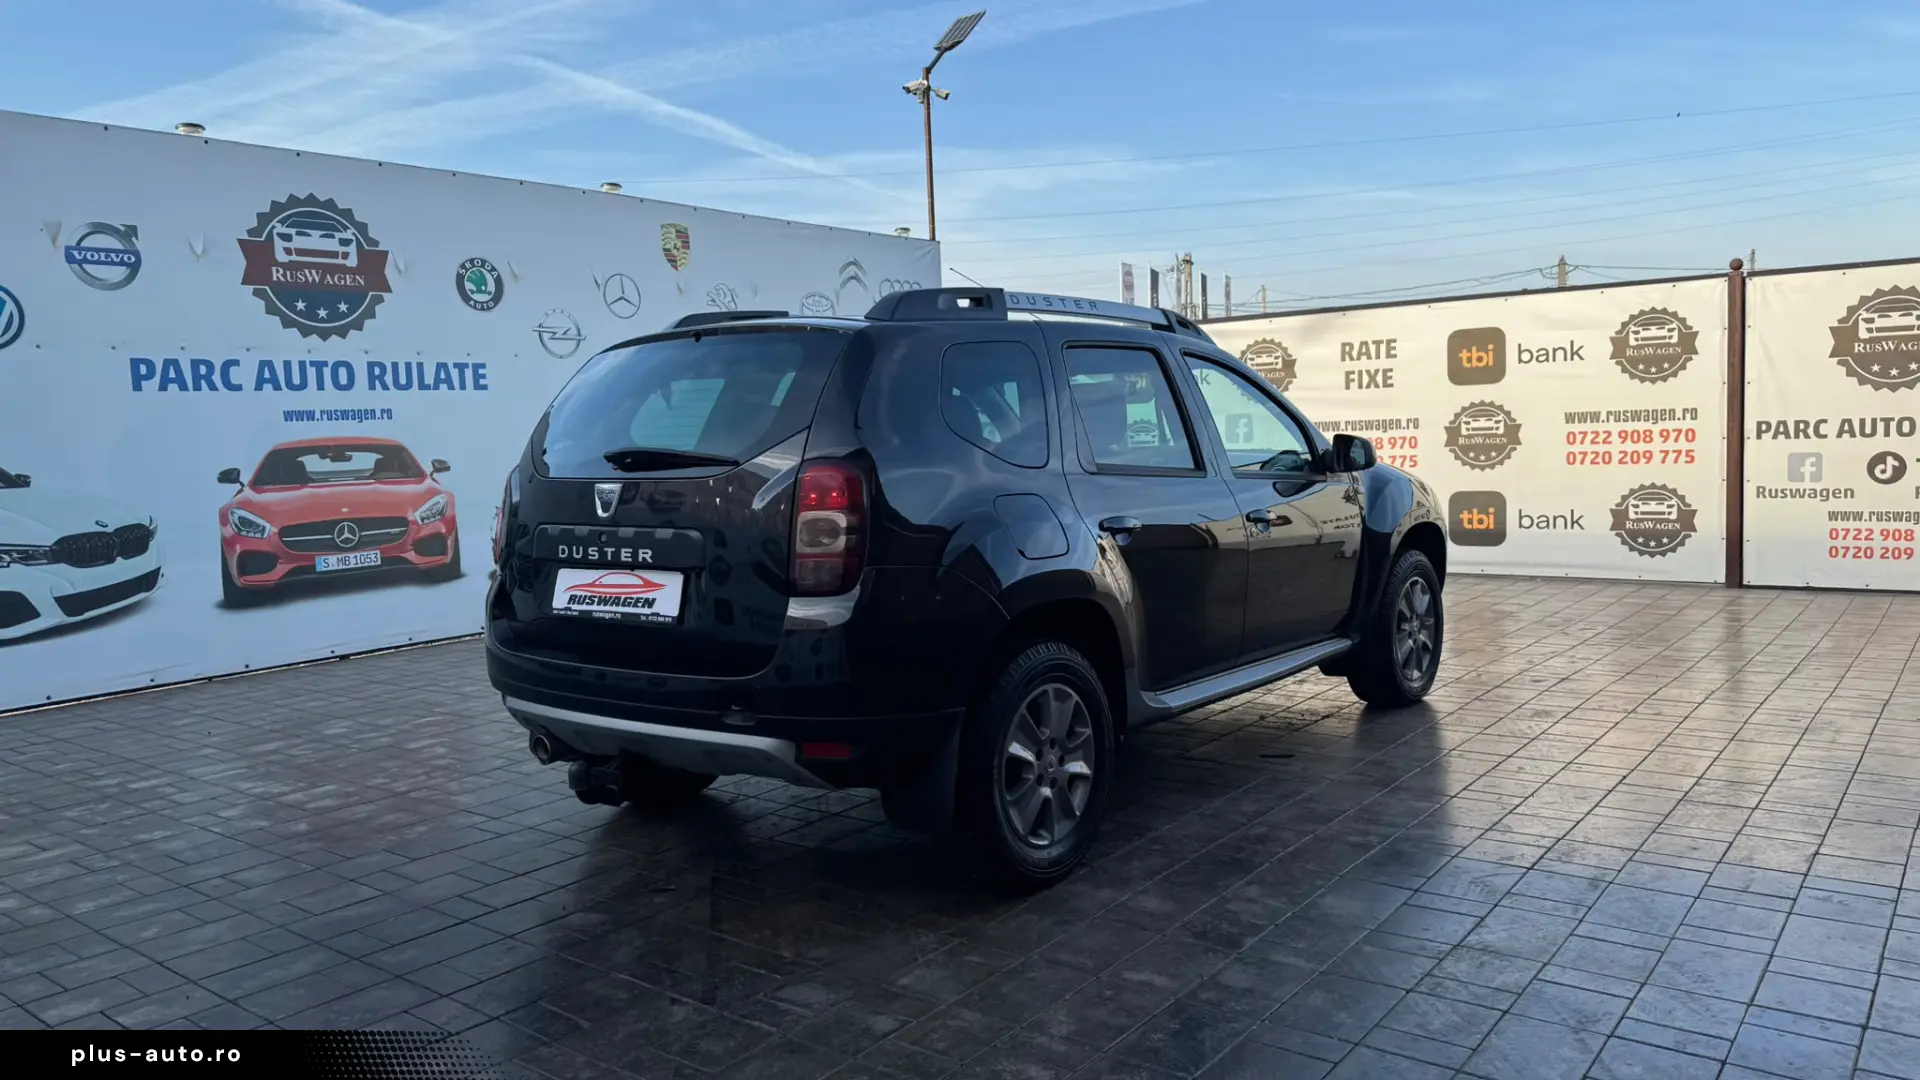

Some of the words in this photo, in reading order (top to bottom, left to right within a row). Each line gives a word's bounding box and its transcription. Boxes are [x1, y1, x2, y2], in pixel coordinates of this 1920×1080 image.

[69, 249, 137, 264] VOLVO
[468, 300, 495, 310] AUTO
[1010, 293, 1101, 312] DUSTER
[1340, 338, 1398, 362] RATE
[1458, 344, 1495, 369] tbi
[1517, 340, 1585, 365] bank
[129, 357, 243, 392] PARC
[254, 359, 356, 392] AUTO
[367, 360, 489, 391] RULATE
[1344, 367, 1394, 390] FIXE
[283, 408, 393, 424] www.ruswagen.ro
[1564, 407, 1698, 425] www.ruswagen.ro
[1566, 430, 1613, 446] 0722
[1617, 429, 1654, 445] 908
[1659, 428, 1696, 444] 970
[1755, 419, 1828, 440] PARC
[1836, 416, 1917, 438] AUTO
[1387, 436, 1418, 449] 970
[1388, 455, 1418, 468] 775
[1566, 450, 1613, 466] 0720
[1617, 450, 1654, 465] 209
[1659, 449, 1696, 465] 775
[1756, 485, 1855, 502] Ruswagen
[1460, 507, 1495, 530] tbi
[1518, 509, 1585, 530] bank
[1828, 527, 1875, 541] 0722
[1879, 528, 1915, 542] 908
[353, 552, 379, 566] 1053
[558, 545, 653, 563] DUSTER
[1828, 546, 1875, 559] 0720
[1879, 546, 1915, 560] 209
[567, 593, 657, 610] RUSWAGEN
